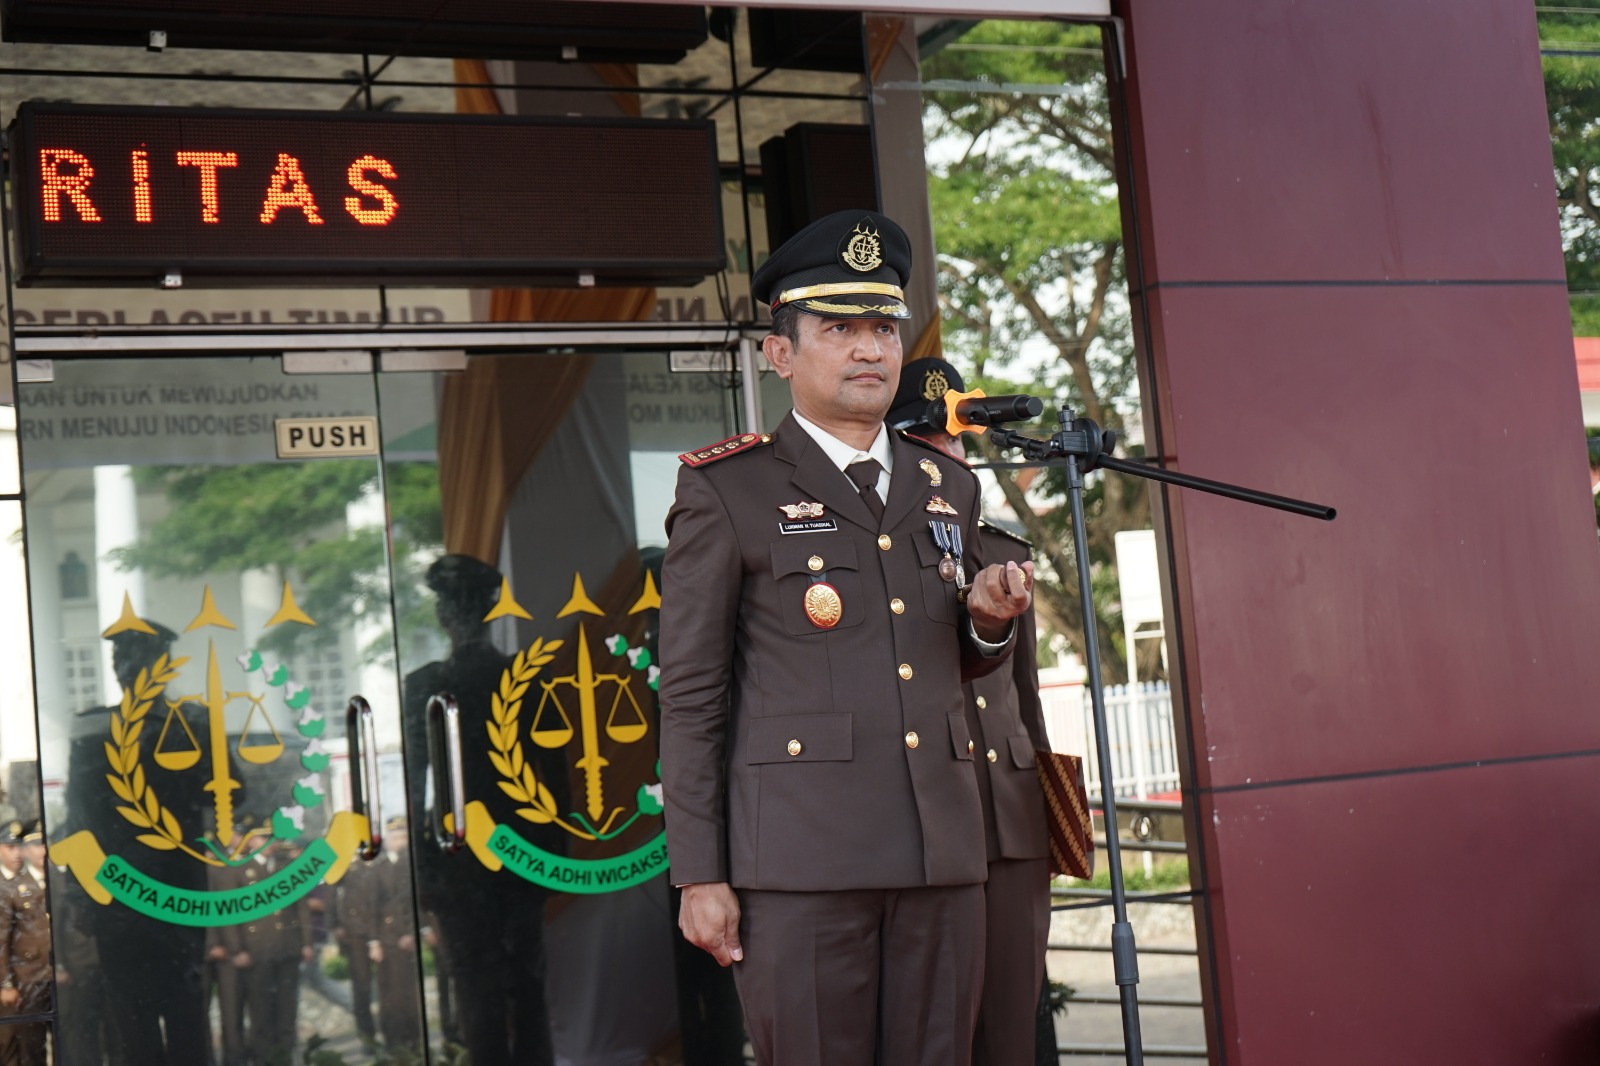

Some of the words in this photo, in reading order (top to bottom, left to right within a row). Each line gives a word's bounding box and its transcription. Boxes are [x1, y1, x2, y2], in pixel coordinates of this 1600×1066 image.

[41, 148, 398, 225] RITAS
[62, 414, 158, 437] MENUJU
[289, 425, 366, 448] PUSH
[495, 835, 545, 877] SATYA
[549, 865, 592, 885] ADHI
[103, 863, 158, 907] SATYA
[162, 896, 210, 916] ADHI
[215, 856, 325, 916] WICAKSANA
